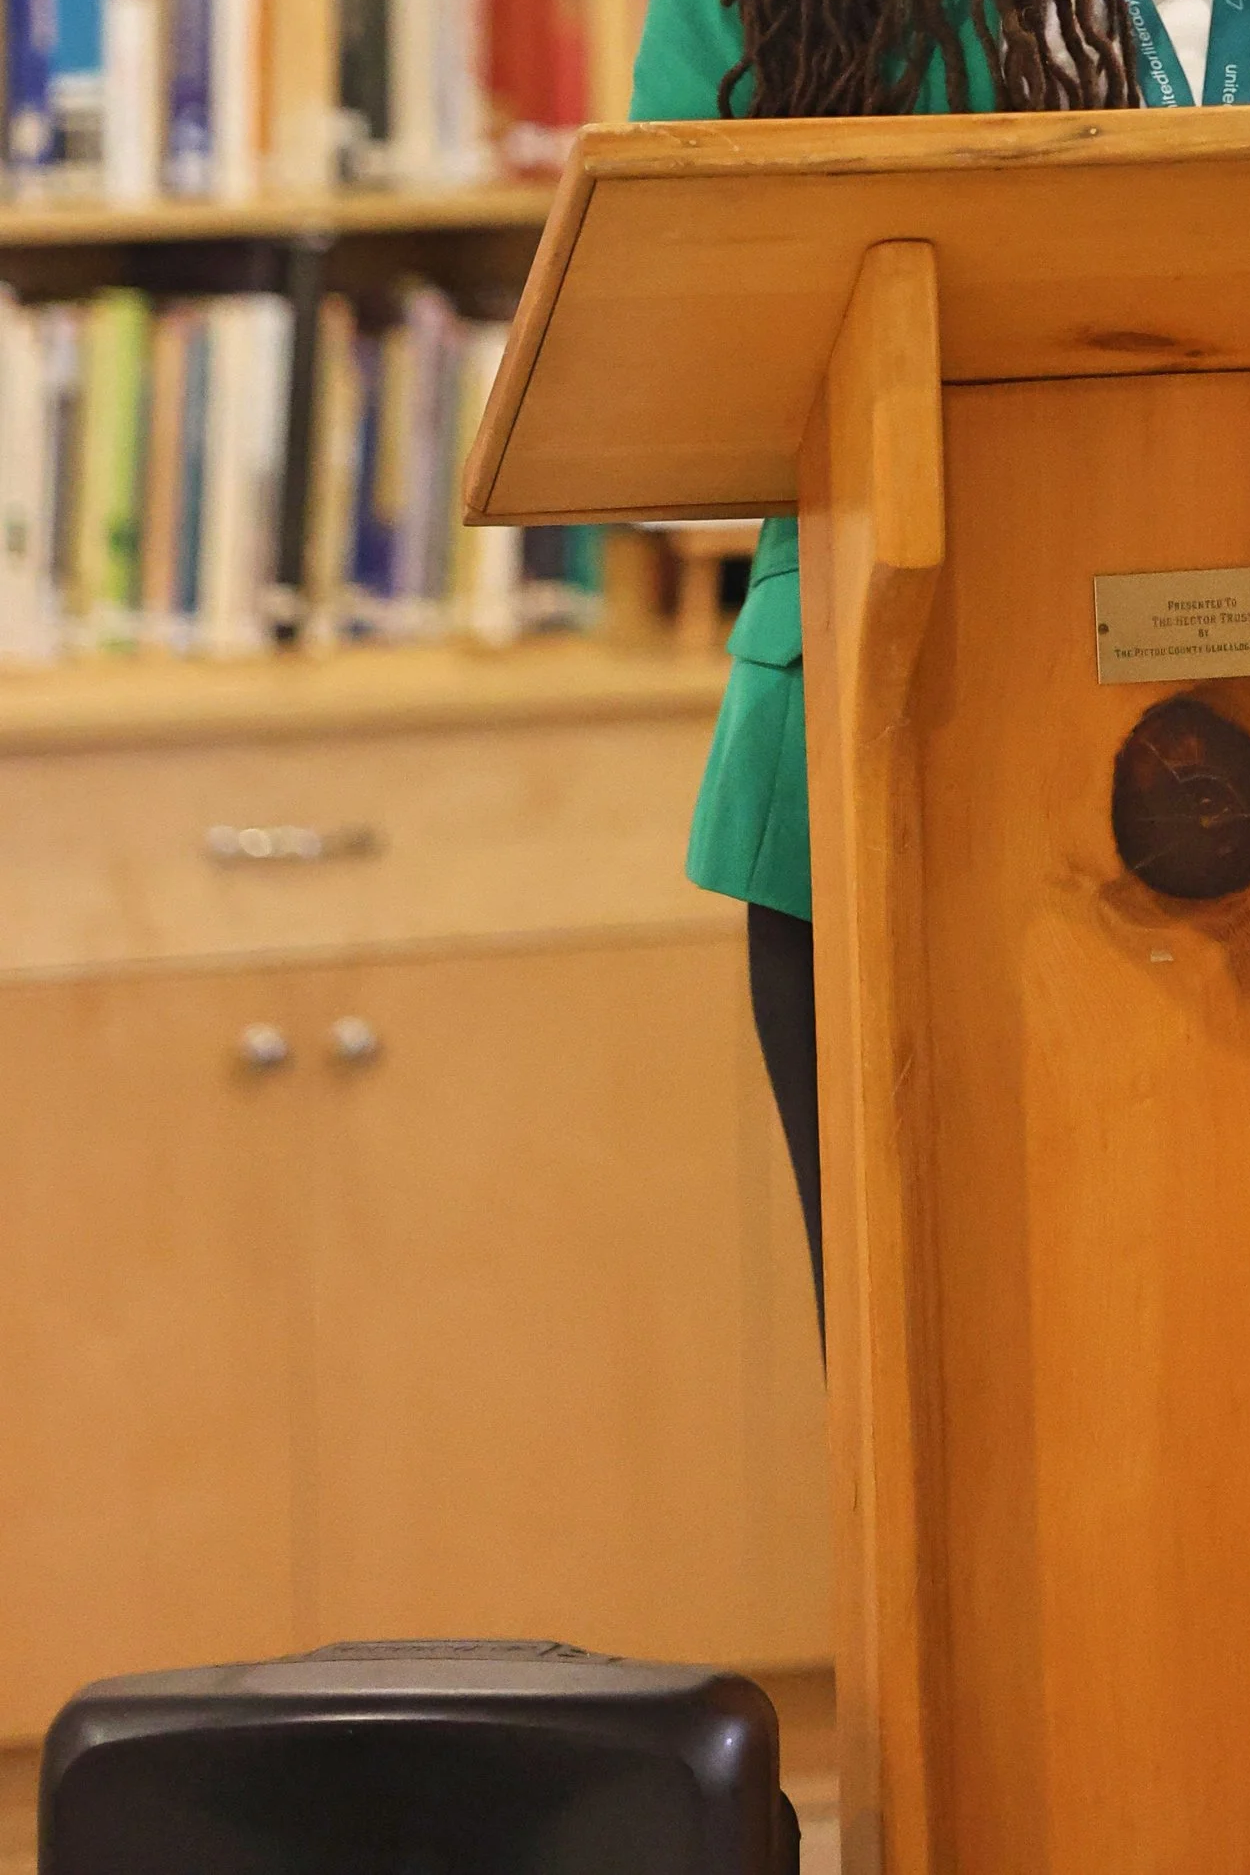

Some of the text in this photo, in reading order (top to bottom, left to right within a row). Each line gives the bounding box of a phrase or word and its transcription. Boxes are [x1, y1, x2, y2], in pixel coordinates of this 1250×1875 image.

[1222, 64, 1238, 107] unite
[1152, 616, 1172, 628] THE
[1176, 614, 1217, 627] HECTOR
[1114, 649, 1133, 659] THE
[1134, 647, 1166, 658] PICTOU
[1168, 645, 1203, 656] COUNTY
